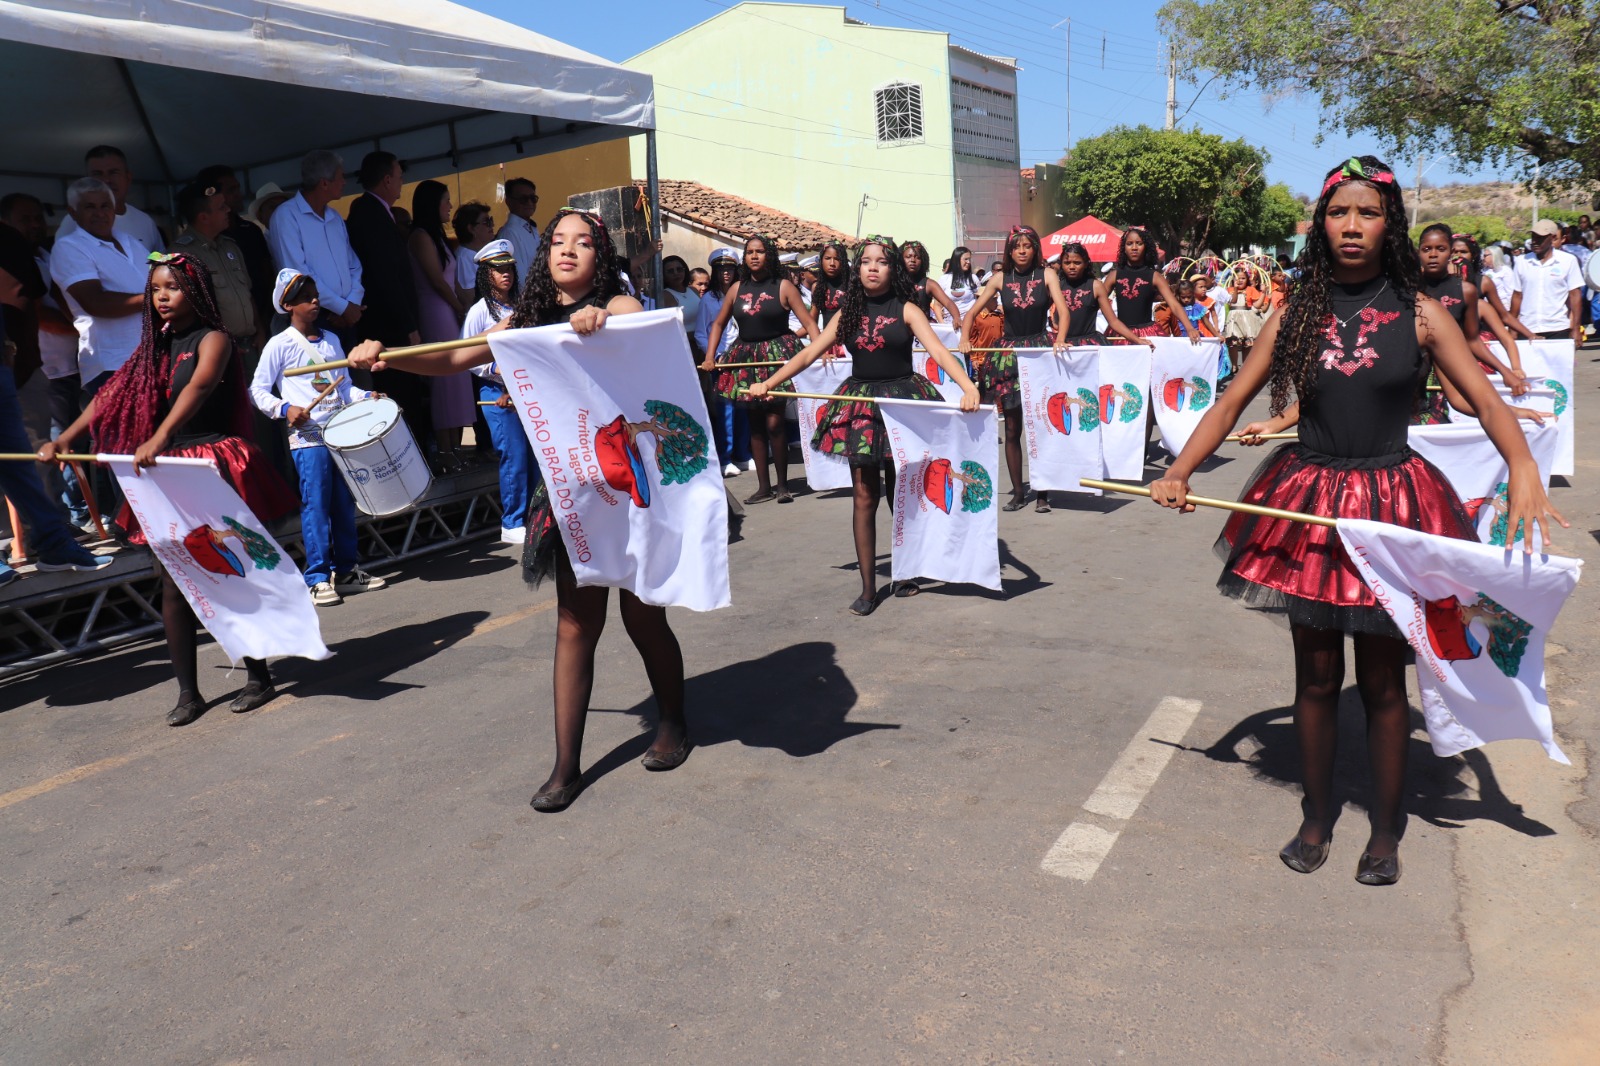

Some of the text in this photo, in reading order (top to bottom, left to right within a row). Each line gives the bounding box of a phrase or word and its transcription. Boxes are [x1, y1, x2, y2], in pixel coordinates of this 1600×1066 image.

[1050, 234, 1107, 245] BRAHMA
[567, 447, 588, 487] Lagoas
[578, 407, 618, 506] Território Quilombo
[896, 447, 909, 472] JOÃO
[372, 464, 387, 475] São
[375, 463, 402, 480] Nonato
[524, 401, 550, 443] JOÃO
[541, 447, 567, 486] BRAZ
[556, 488, 574, 510] DO
[565, 512, 592, 563] ROSÁRIO
[898, 474, 907, 494] BRAZ
[898, 496, 906, 508] DO
[172, 563, 186, 577] DO
[183, 579, 215, 619] ROSÁRIO
